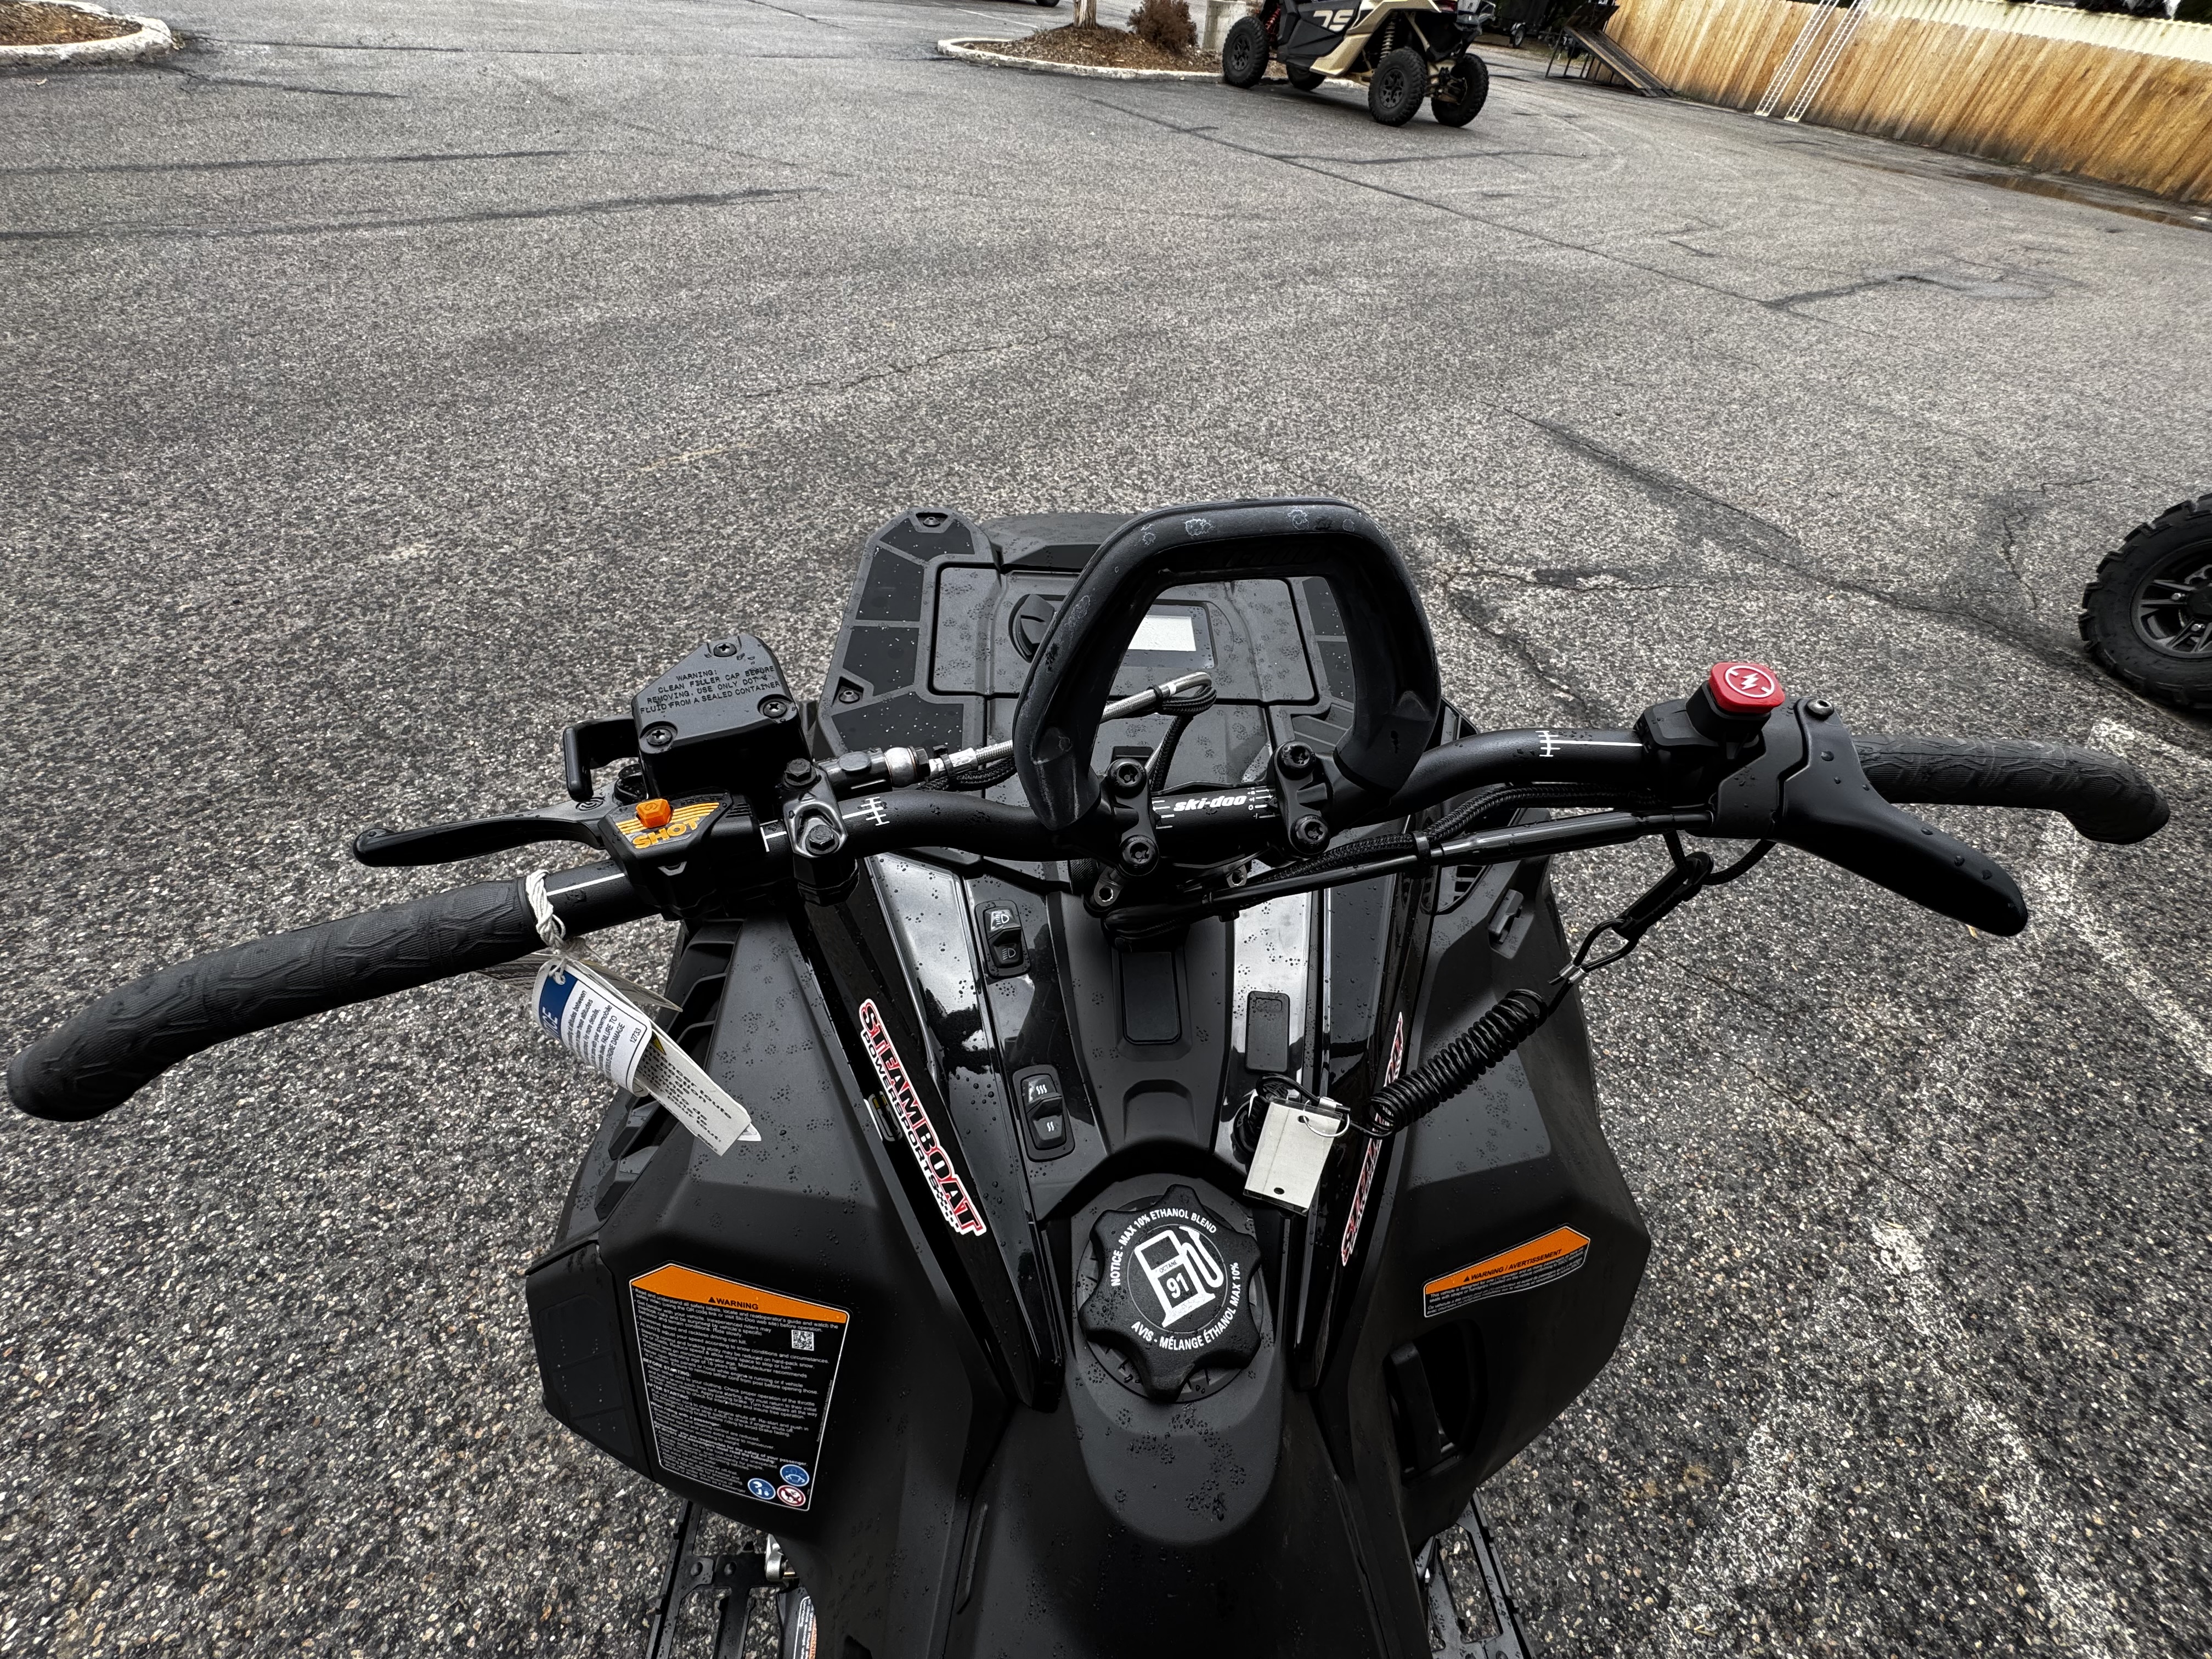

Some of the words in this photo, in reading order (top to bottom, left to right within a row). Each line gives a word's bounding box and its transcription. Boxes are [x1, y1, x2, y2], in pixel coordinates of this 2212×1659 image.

[658, 683, 685, 693] CLEAN
[690, 676, 720, 687] FILLER
[745, 665, 775, 676] BEFORE
[676, 669, 718, 681] WARNING:
[640, 704, 667, 714] FLUID
[669, 699, 691, 708] FROM
[694, 695, 699, 703] A
[701, 691, 732, 702] SEALED
[647, 691, 694, 704] REMOVING.
[697, 686, 713, 694] USE
[718, 680, 737, 690] ONLY
[1173, 795, 1247, 811] ski-doo
[632, 817, 700, 849] SHOT
[573, 989, 587, 1012] between
[580, 998, 593, 1019] altitudes
[588, 1007, 601, 1025] details,
[595, 1003, 612, 1033] snowmobile
[600, 1023, 614, 1044] FAILURE
[609, 1014, 618, 1024] TO
[611, 1022, 625, 1046] DAMAGE
[629, 1026, 642, 1044] 12733
[861, 1001, 984, 1231] STEAMBOAT
[862, 1031, 939, 1192] POWERSPORTS
[1111, 1250, 1124, 1286] NOTICE
[1118, 1225, 1137, 1246] MAX
[1134, 1214, 1151, 1229] 10%
[1150, 1208, 1189, 1220] ETHANOL
[1190, 1212, 1217, 1234] BLEND
[1159, 1261, 1178, 1274] OCTANE
[1229, 1262, 1240, 1282] 10%
[1471, 1265, 1504, 1280] WARNING
[1508, 1249, 1562, 1271] AVERTISSEMENT
[1166, 1273, 1190, 1299] 91
[1231, 1283, 1241, 1308] MAX
[716, 1298, 759, 1310] WARNING
[1131, 1321, 1154, 1342] AVIS
[1204, 1307, 1236, 1344] ÉTHANOL
[1159, 1335, 1204, 1351] MÉLANGE
